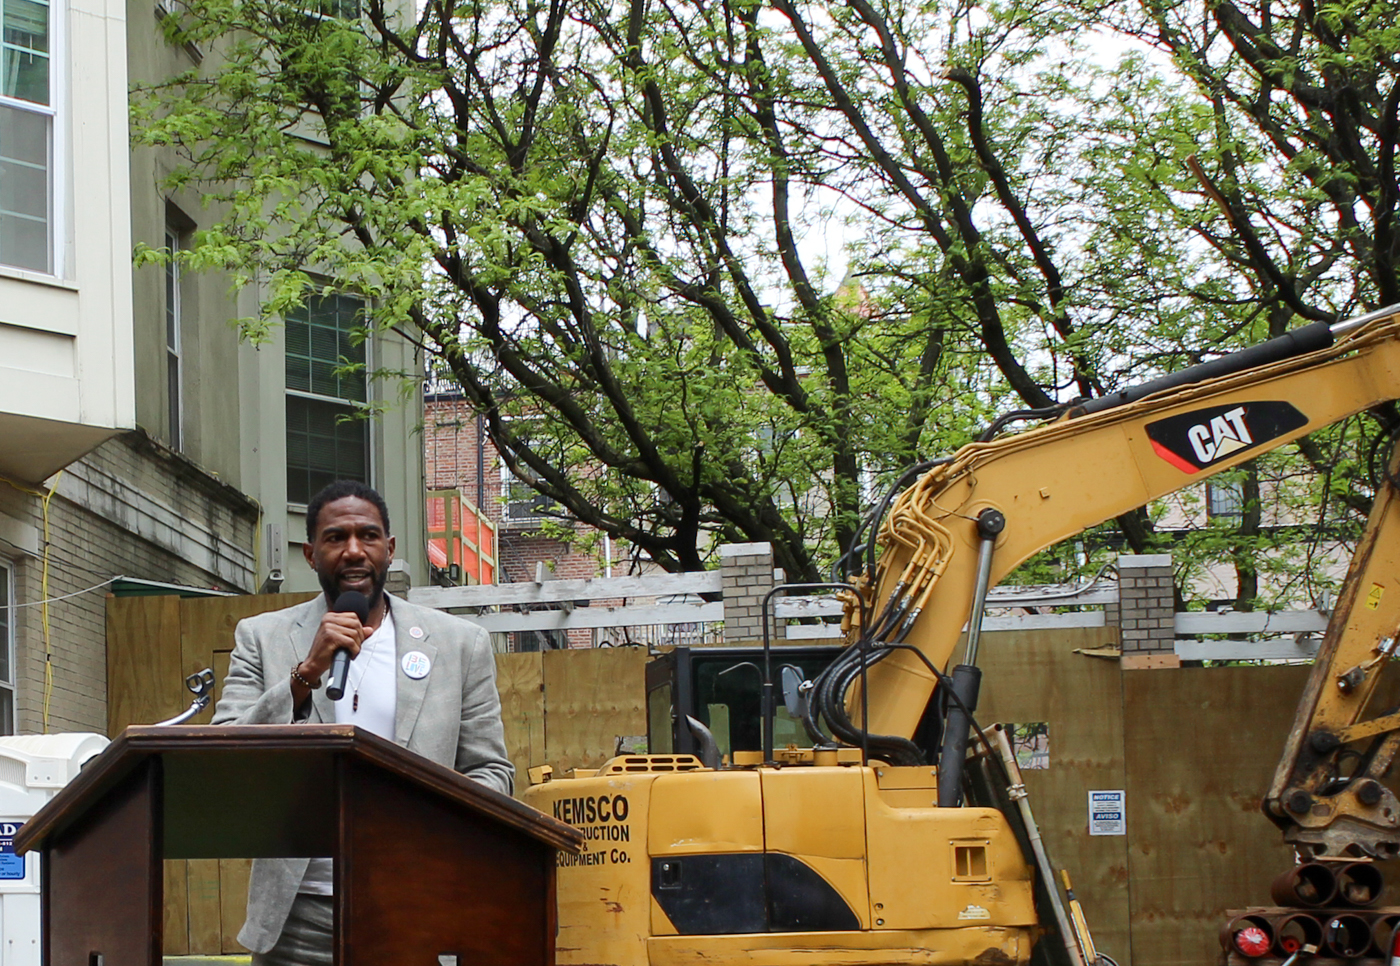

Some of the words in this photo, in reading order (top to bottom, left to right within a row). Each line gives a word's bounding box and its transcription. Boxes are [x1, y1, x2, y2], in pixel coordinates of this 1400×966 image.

[1187, 406, 1252, 463] CAT
[553, 794, 628, 824] KEMSCO
[579, 825, 630, 842] RUCTION
[583, 842, 588, 851] &
[611, 848, 630, 863] Co.
